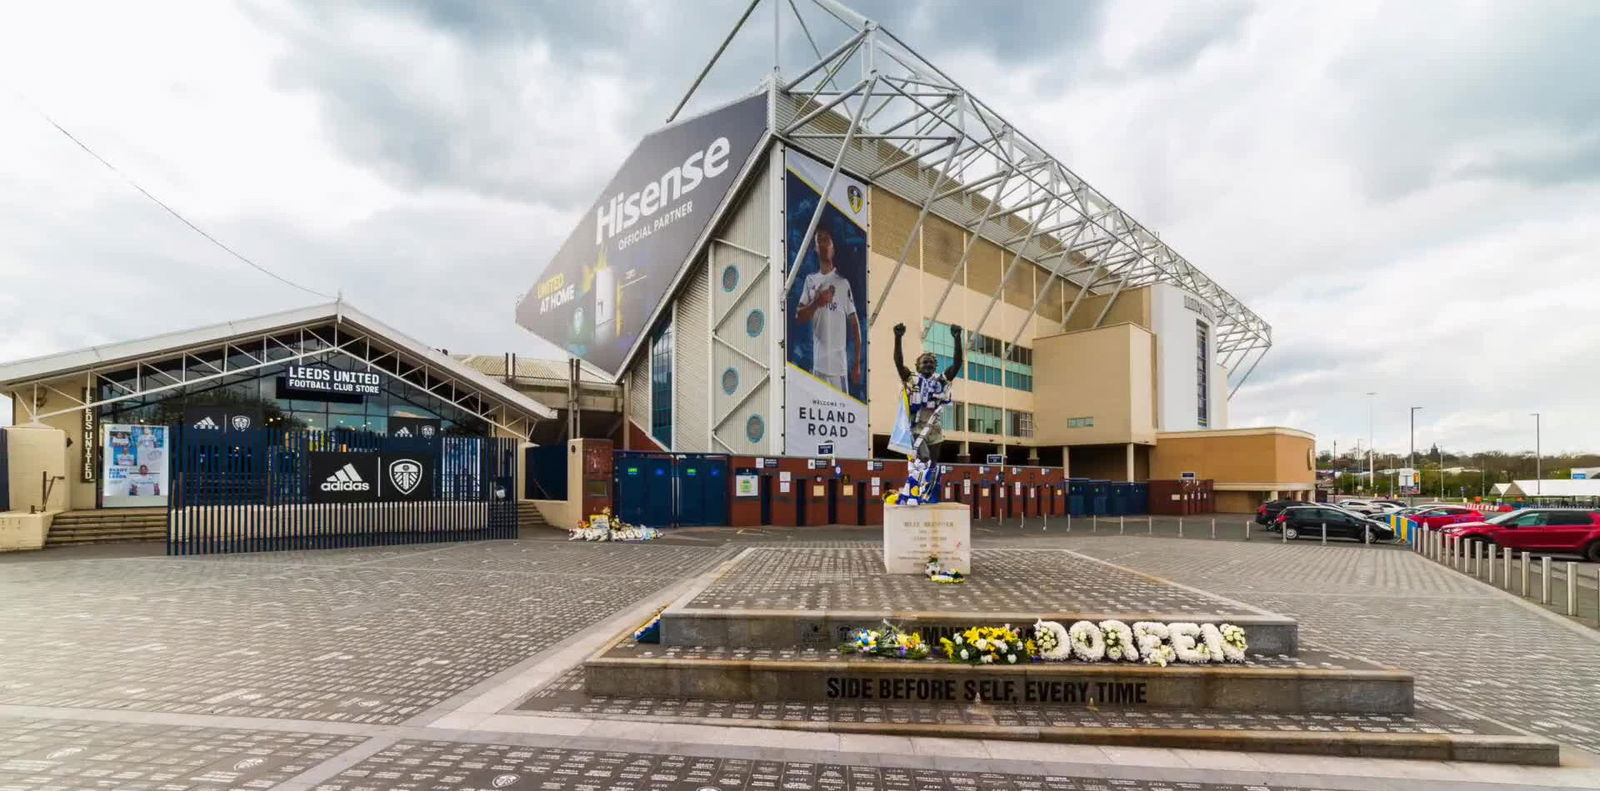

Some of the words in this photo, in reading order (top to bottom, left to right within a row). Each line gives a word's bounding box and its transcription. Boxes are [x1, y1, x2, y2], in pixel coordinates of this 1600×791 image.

[596, 137, 730, 245] Hisense
[618, 224, 652, 251] OFFICIAL
[653, 200, 693, 232] PARTNER
[537, 273, 565, 300] UNITED
[539, 296, 550, 315] AT
[550, 283, 576, 310] HOME
[289, 366, 330, 381] LEEDS
[333, 370, 380, 385] UNITED
[289, 379, 331, 390] FOOTBALL
[333, 382, 353, 392] CLUB
[355, 385, 380, 394] STORE
[799, 406, 856, 424] ELLAND
[808, 423, 848, 438] ROAD
[320, 481, 370, 492] adidas
[1033, 617, 1248, 667] DOREEN
[827, 677, 873, 699] SIDE
[879, 678, 956, 701] BEFORE
[964, 680, 1018, 703] SELF,
[1025, 681, 1088, 703] EVERY
[1095, 682, 1147, 704] TIME
